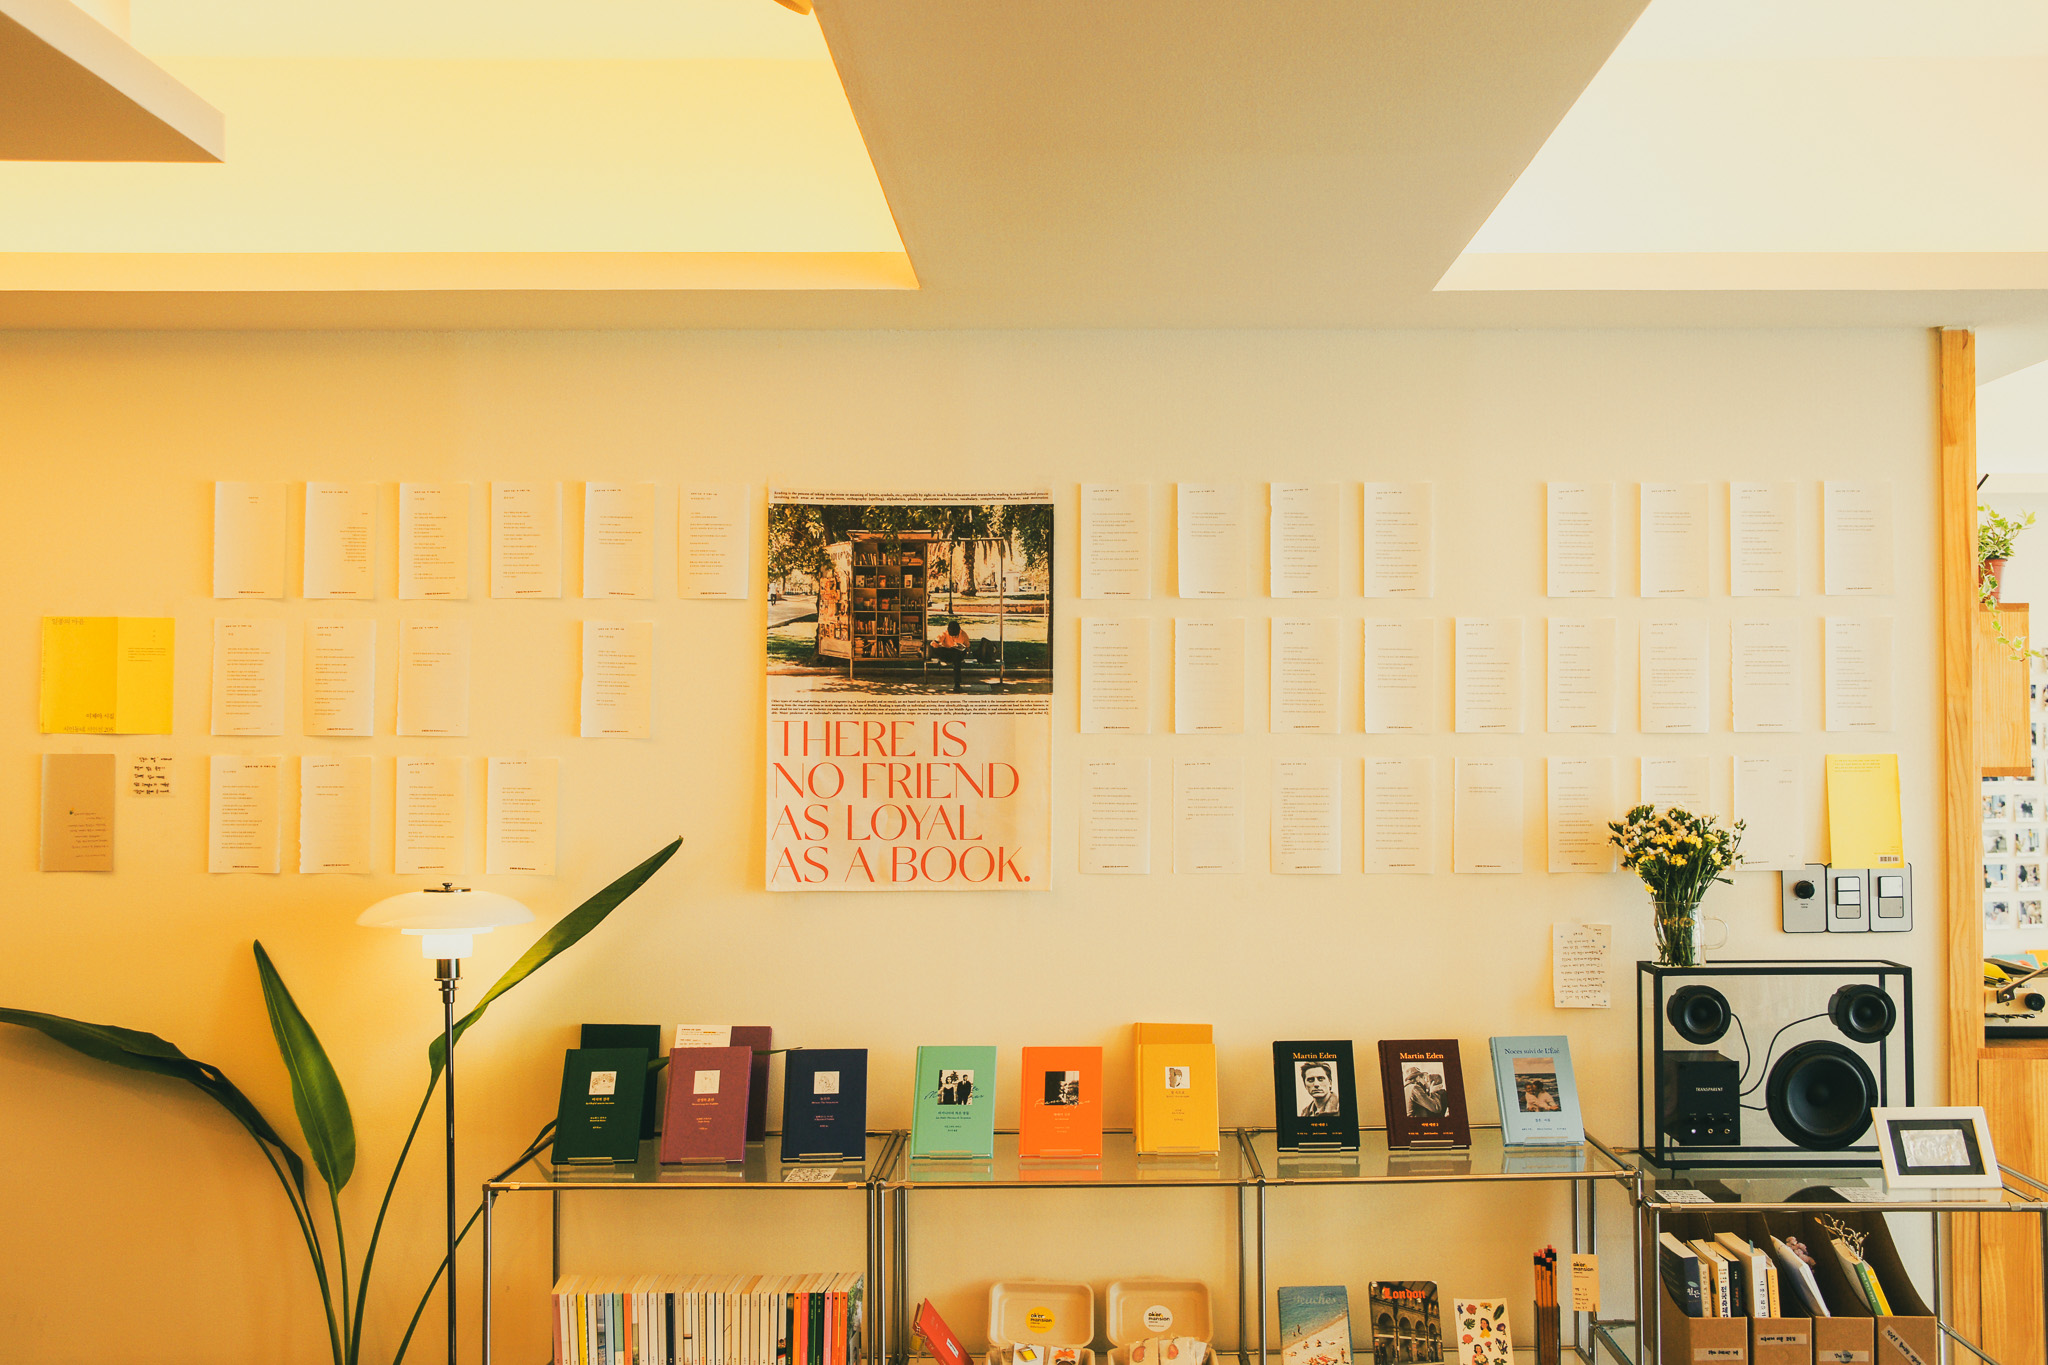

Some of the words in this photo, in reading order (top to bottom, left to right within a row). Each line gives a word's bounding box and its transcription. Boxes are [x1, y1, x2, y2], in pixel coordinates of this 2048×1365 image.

[772, 720, 916, 758] THERE
[932, 720, 968, 758] IS
[772, 762, 845, 799] NO
[862, 762, 1020, 799] FRIEND
[772, 804, 830, 841] AS
[847, 804, 983, 841] LOYAL
[772, 846, 830, 884] AS
[844, 846, 876, 884] A
[891, 846, 1031, 884] BOOK.
[1383, 1288, 1426, 1300] London
